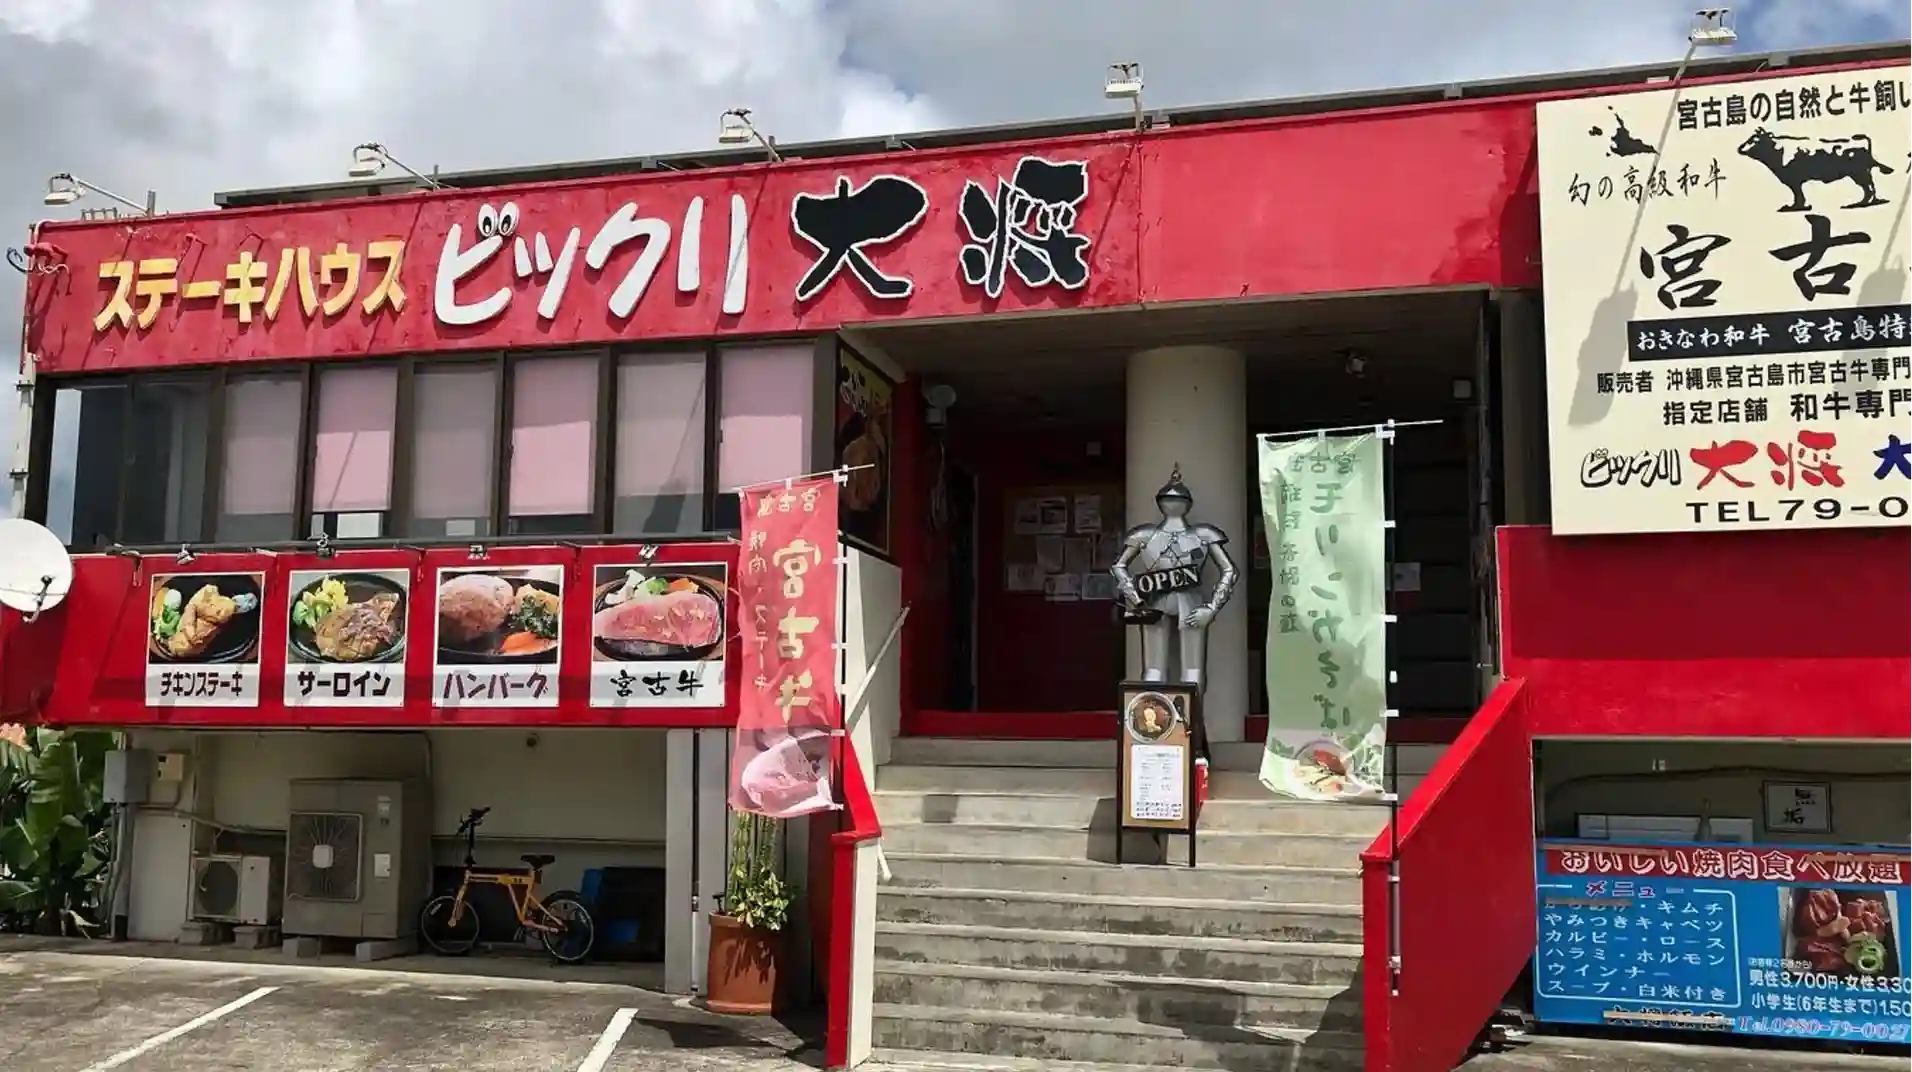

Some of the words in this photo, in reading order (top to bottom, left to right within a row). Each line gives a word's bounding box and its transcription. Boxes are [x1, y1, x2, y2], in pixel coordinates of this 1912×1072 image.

[1568, 157, 1729, 206] 幻の高級和牛
[94, 240, 406, 332] ステーキハウス
[434, 194, 748, 325] ビックリ
[791, 156, 1091, 301] 大将
[1640, 214, 1912, 309] 宮古
[1636, 321, 1771, 351] おきなわ和牛
[1787, 312, 1912, 345] 宮古島特
[1597, 369, 1654, 394] 販売者
[1666, 356, 1910, 391] 沖縄県宮古島市宮古牛専門
[1663, 397, 1768, 426] 指定店舗
[1790, 389, 1912, 422] 和牛専門
[1580, 448, 1682, 488] ビックリ
[1689, 429, 1845, 491] 大将
[1138, 566, 1198, 593] OPEN
[160, 671, 243, 697] チキンステーキ
[297, 670, 391, 697] サーロイン
[443, 671, 549, 699] ハンバーグ
[609, 668, 704, 698] 宮古牛
[1562, 848, 1904, 884] おいしい焼肉食べ放題
[1586, 880, 1685, 898] メニュー
[1544, 914, 1723, 932] やみつきキャベツ
[1545, 930, 1725, 949] カルビー・ロース
[1545, 947, 1725, 966] ハラミ・ホルモン
[1548, 962, 1671, 978] ウインナー
